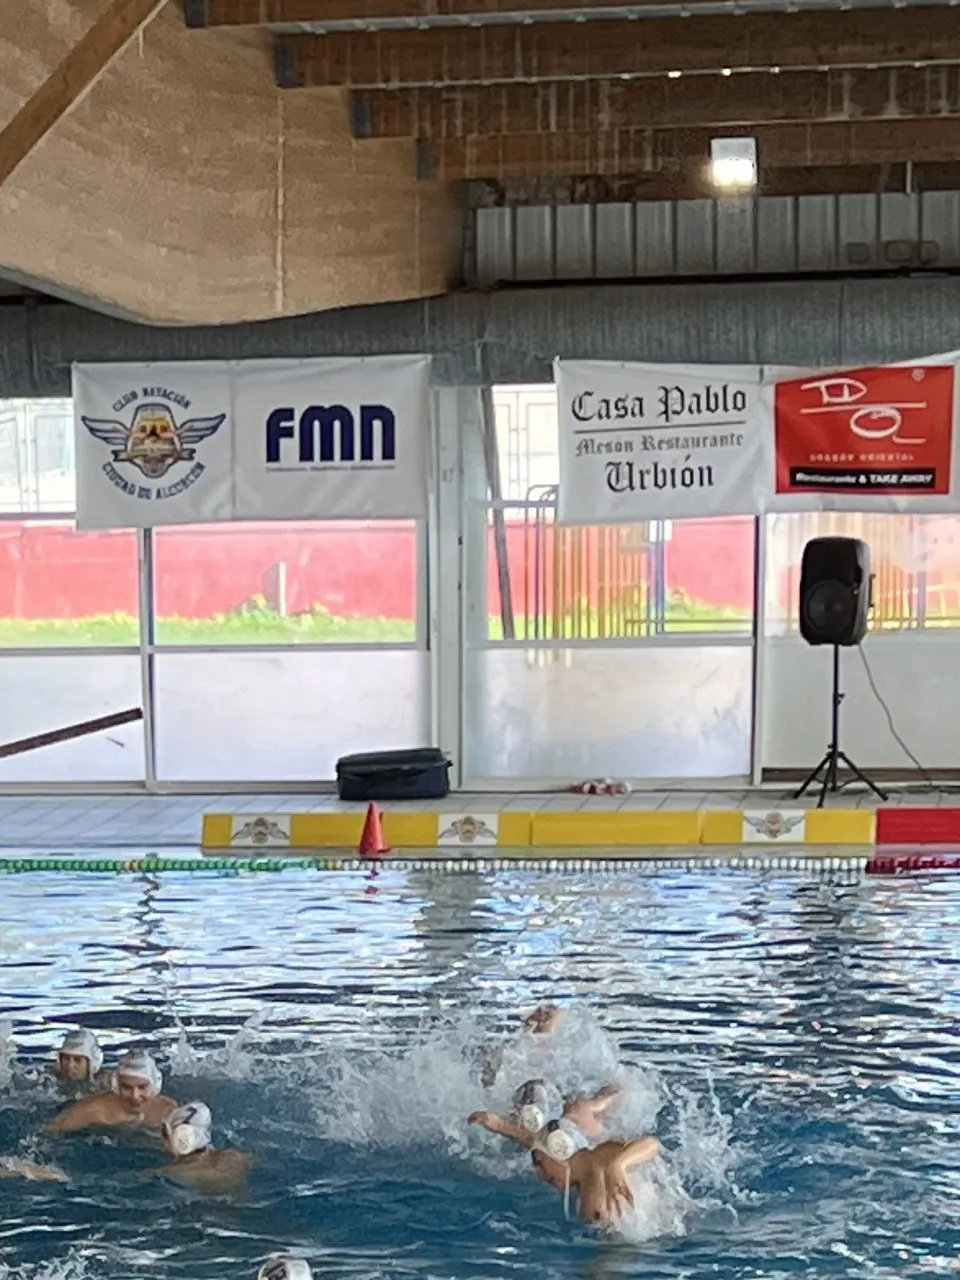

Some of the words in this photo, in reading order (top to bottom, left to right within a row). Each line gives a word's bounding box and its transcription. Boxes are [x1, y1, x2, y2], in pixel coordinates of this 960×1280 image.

[571, 390, 645, 422] Casa
[656, 384, 747, 422] Pablo
[641, 432, 744, 452] Restaurante
[604, 454, 714, 493] Urbión
[858, 473, 867, 485] &
